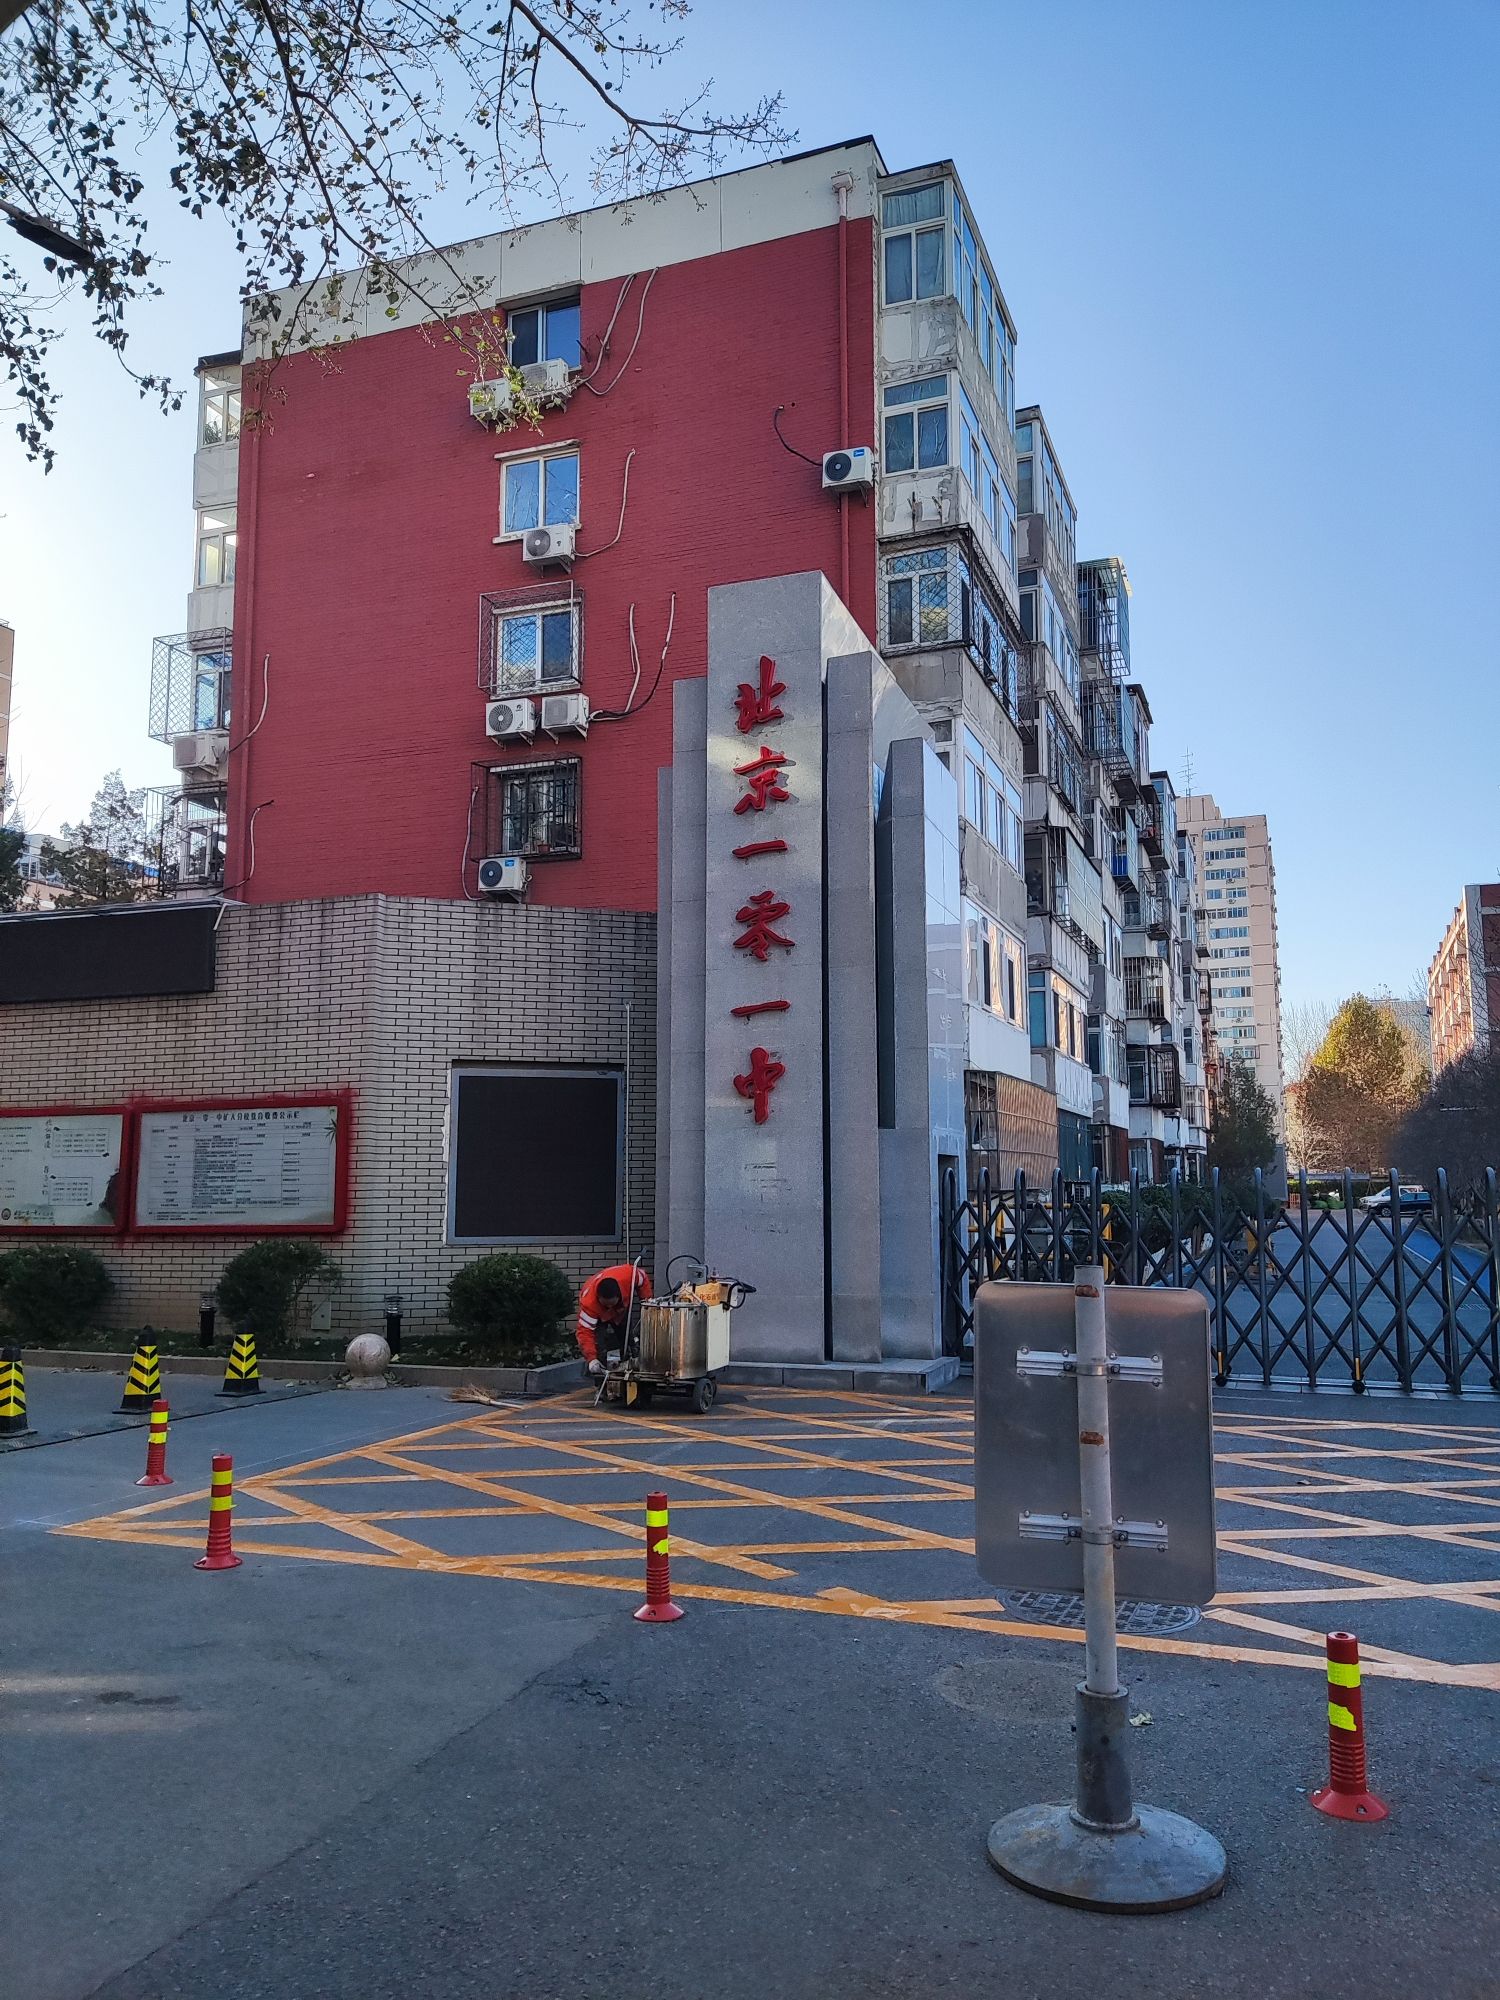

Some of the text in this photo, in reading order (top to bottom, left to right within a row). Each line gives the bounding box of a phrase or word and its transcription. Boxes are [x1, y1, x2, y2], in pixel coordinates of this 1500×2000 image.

[731, 654, 794, 1125] 北京一零一中
